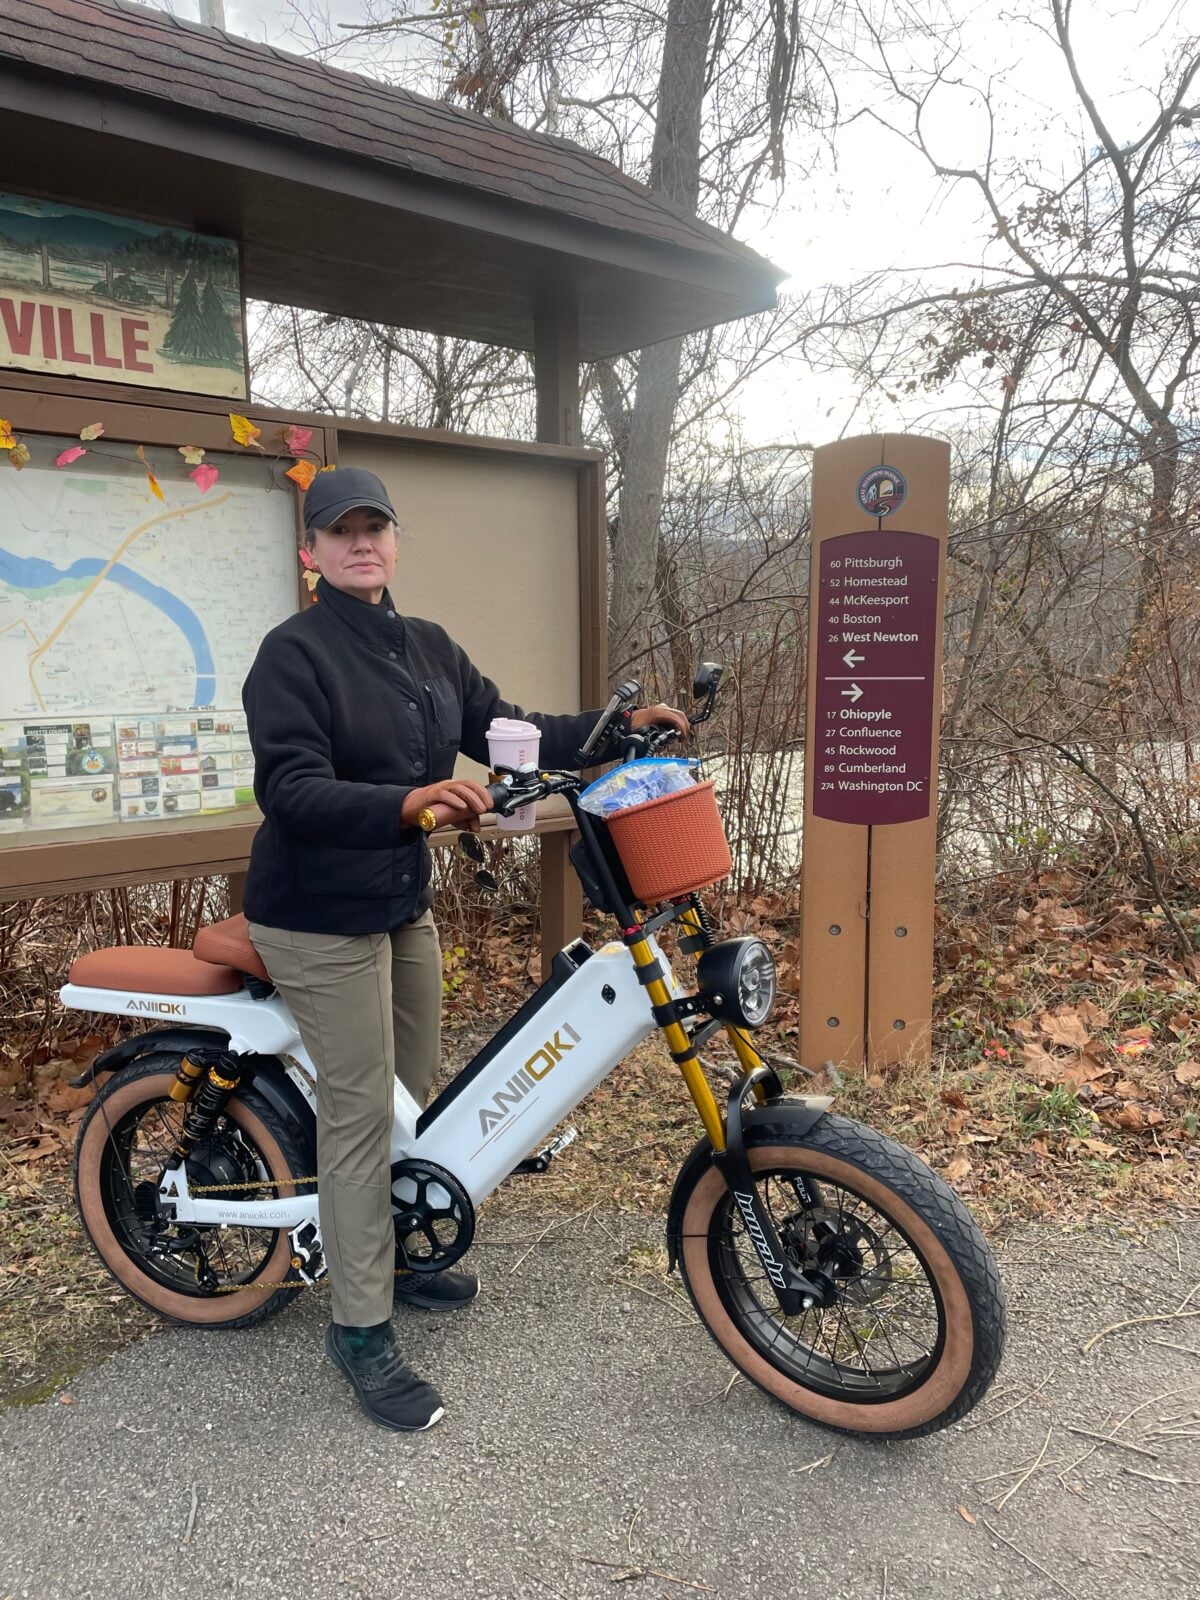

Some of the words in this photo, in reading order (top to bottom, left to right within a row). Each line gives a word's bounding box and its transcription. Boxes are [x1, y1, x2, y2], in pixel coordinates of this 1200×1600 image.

[0, 297, 154, 374] VILLE
[830, 560, 842, 568] 60
[844, 556, 904, 570] Pittsburgh
[829, 579, 841, 588] 52
[843, 575, 908, 587] Homestead
[829, 597, 840, 606] 44
[843, 594, 910, 608] McKeesport
[828, 616, 839, 625] 40
[842, 613, 882, 624] Boston
[828, 634, 839, 643] 26
[842, 632, 871, 643] West
[873, 631, 919, 642] Newton
[827, 711, 837, 720] 17
[839, 708, 892, 722] Ohiopyle
[825, 729, 836, 738] 27
[839, 726, 902, 738] Confluence
[825, 747, 836, 756] 45
[839, 744, 897, 756] Rockwood
[824, 764, 835, 773] 89
[838, 762, 906, 774] Cumberland
[820, 782, 835, 791] 274
[838, 780, 904, 793] Washington
[906, 781, 923, 792] DC
[125, 999, 187, 1015] ANIIOKI
[479, 1022, 582, 1137] ANIIOKI
